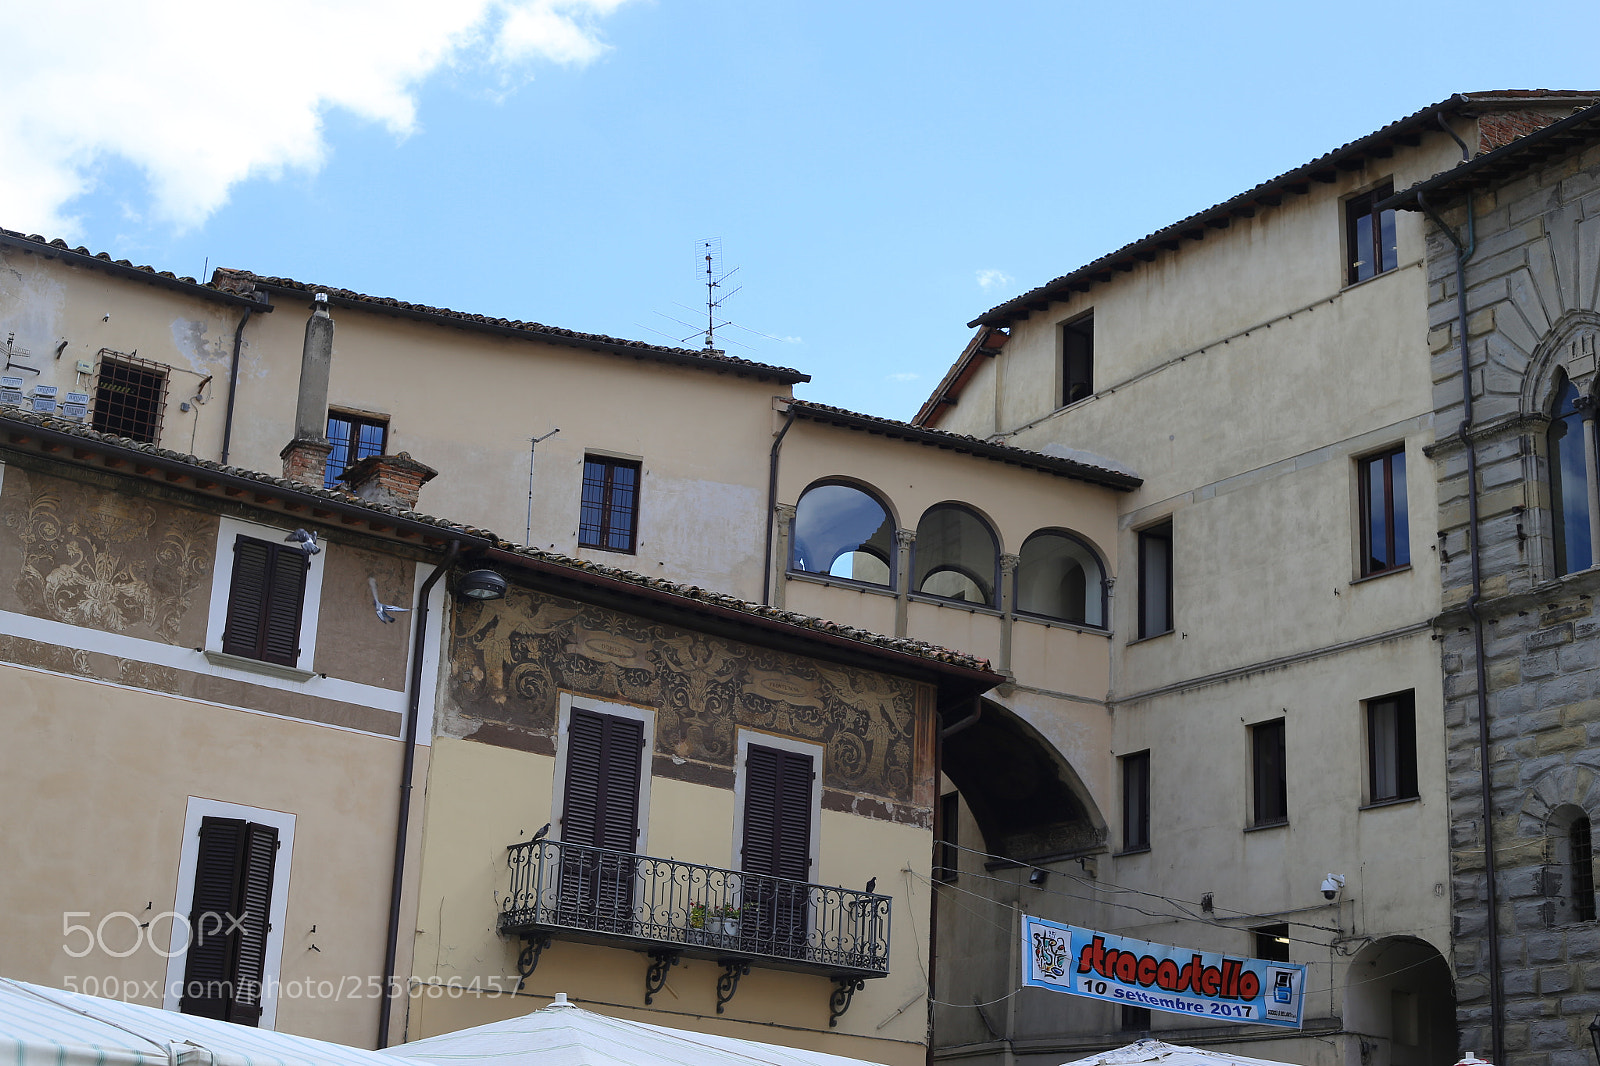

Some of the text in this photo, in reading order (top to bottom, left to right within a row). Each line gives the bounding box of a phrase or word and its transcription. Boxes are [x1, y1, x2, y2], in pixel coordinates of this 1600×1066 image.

[1077, 936, 1259, 1002] stracastello
[1083, 980, 1107, 995] 10
[1114, 987, 1204, 1013] settembre
[1210, 1002, 1252, 1018] 2017
